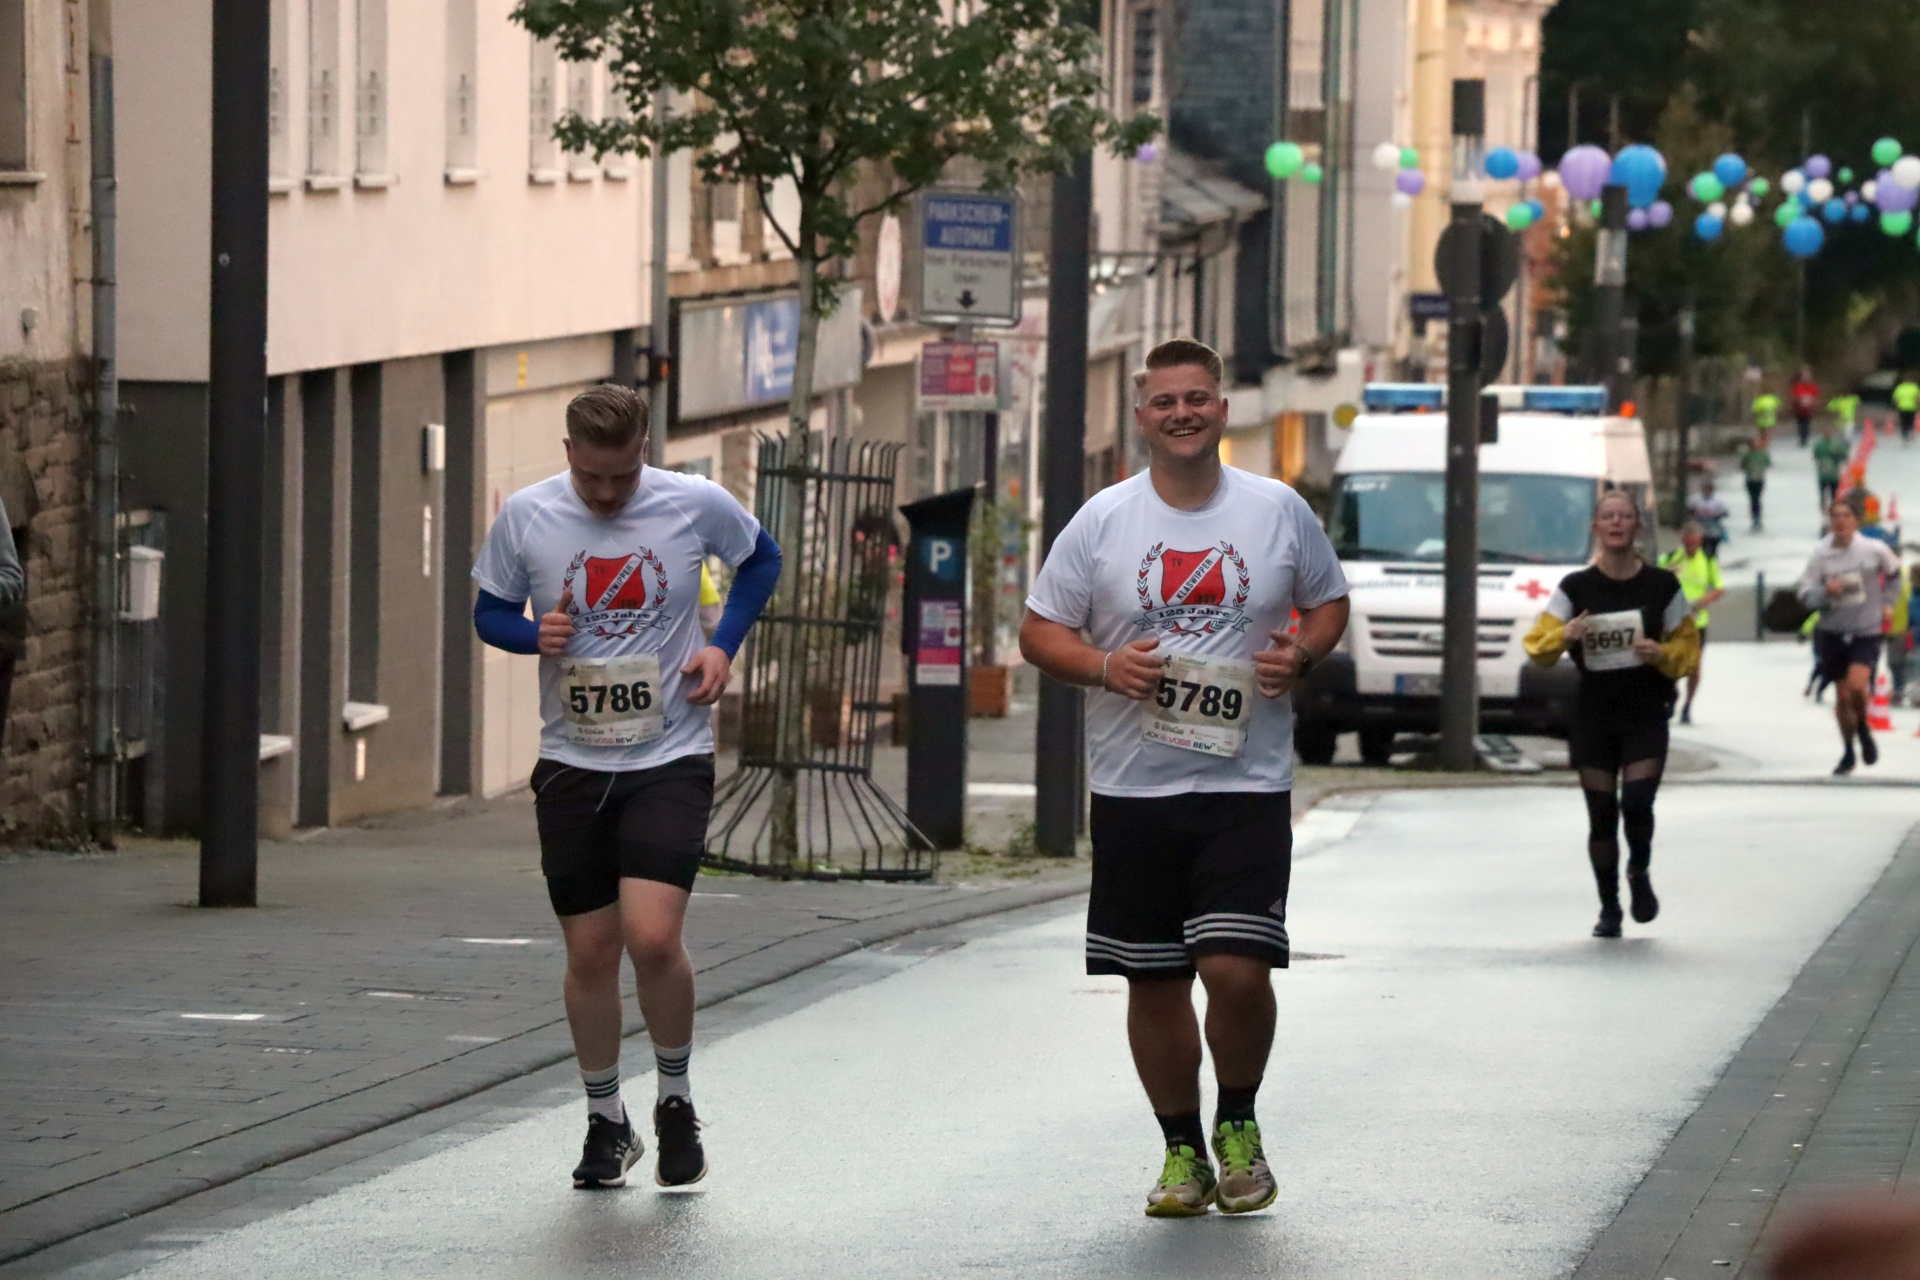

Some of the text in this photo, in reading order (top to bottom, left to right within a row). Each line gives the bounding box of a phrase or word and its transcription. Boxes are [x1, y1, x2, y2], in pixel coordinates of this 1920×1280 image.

[930, 539, 952, 573] P
[600, 564, 634, 607] KLASWIPPER
[1175, 558, 1214, 601] KLASWIPPER
[585, 611, 651, 623] 125 Jahre
[1158, 608, 1231, 618] 125 Jahre
[1586, 627, 1636, 650] 5697
[570, 681, 652, 714] 5786
[1156, 677, 1243, 720] 5789
[1168, 736, 1192, 747] VOSS
[1193, 741, 1212, 751] BEW
